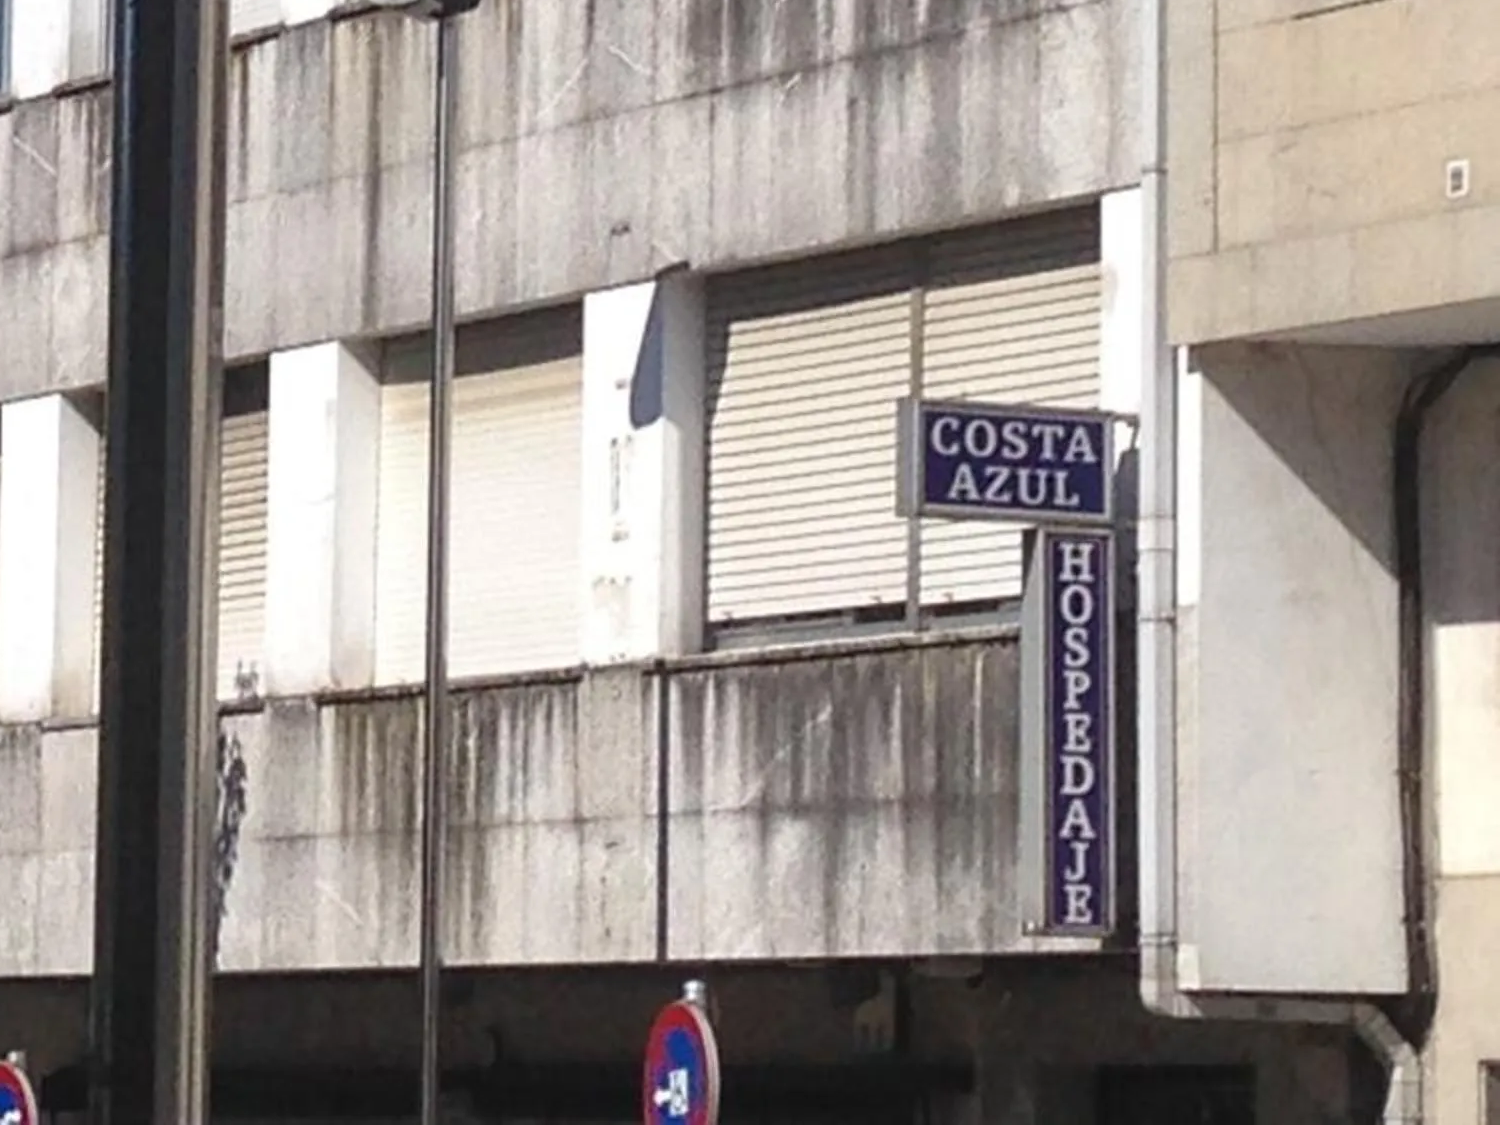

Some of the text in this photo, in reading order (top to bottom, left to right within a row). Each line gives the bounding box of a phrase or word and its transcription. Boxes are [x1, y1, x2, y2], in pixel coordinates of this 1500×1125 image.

[931, 417, 1097, 463] COSTA
[948, 462, 1080, 506] AZUL
[1059, 542, 1096, 925] HOSPEDAJE
